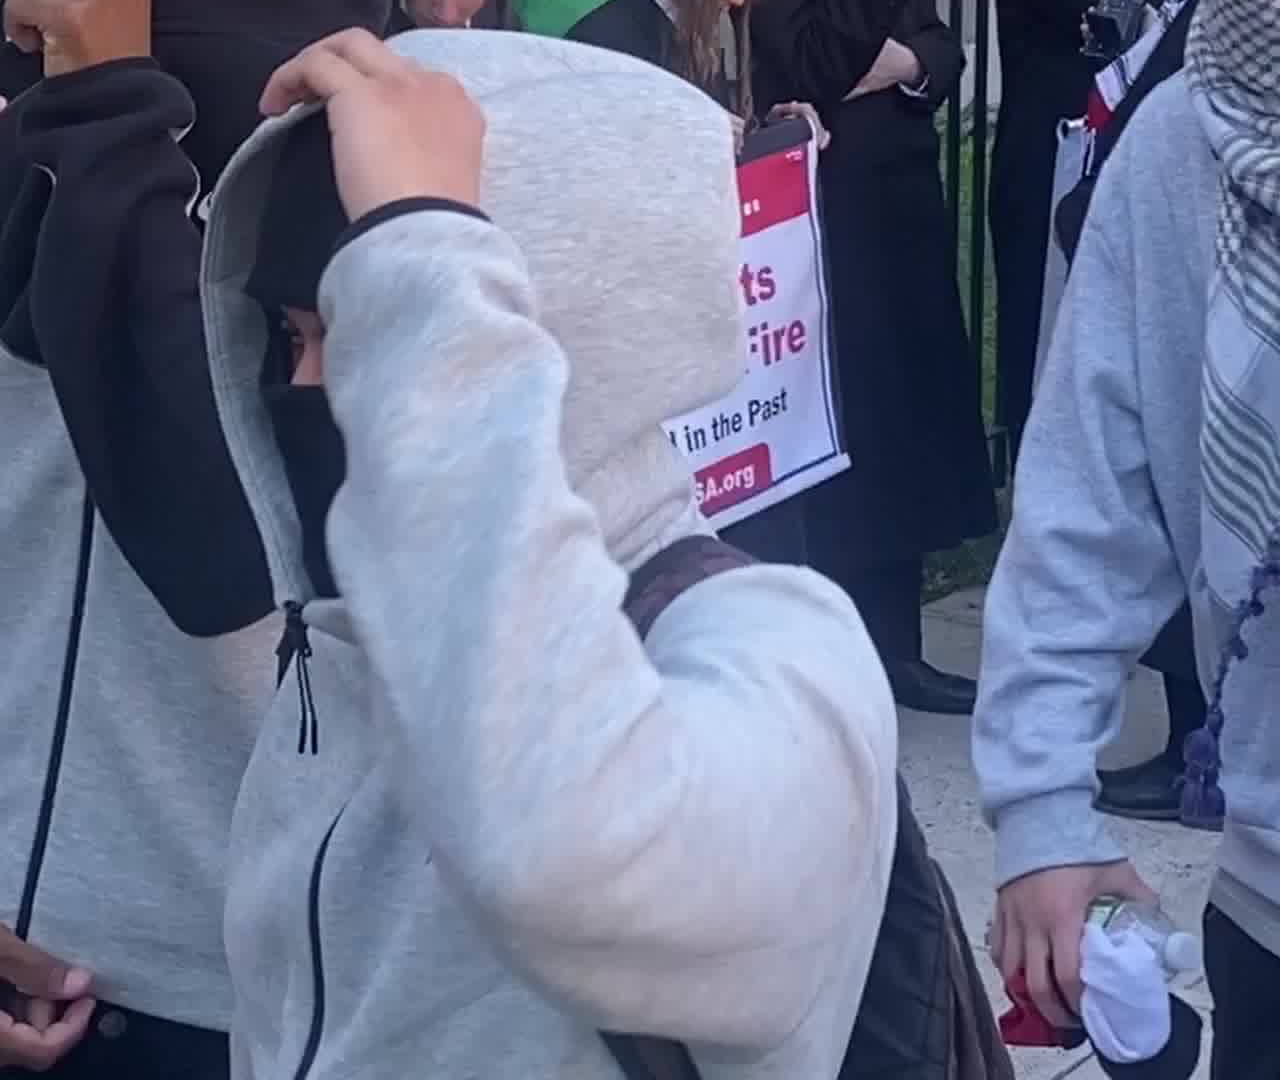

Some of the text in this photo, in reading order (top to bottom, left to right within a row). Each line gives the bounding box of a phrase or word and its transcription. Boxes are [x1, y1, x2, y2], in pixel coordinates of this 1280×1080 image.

[748, 319, 807, 367] ire
[683, 424, 707, 453] in
[711, 412, 743, 442] the
[747, 387, 788, 428] Past
